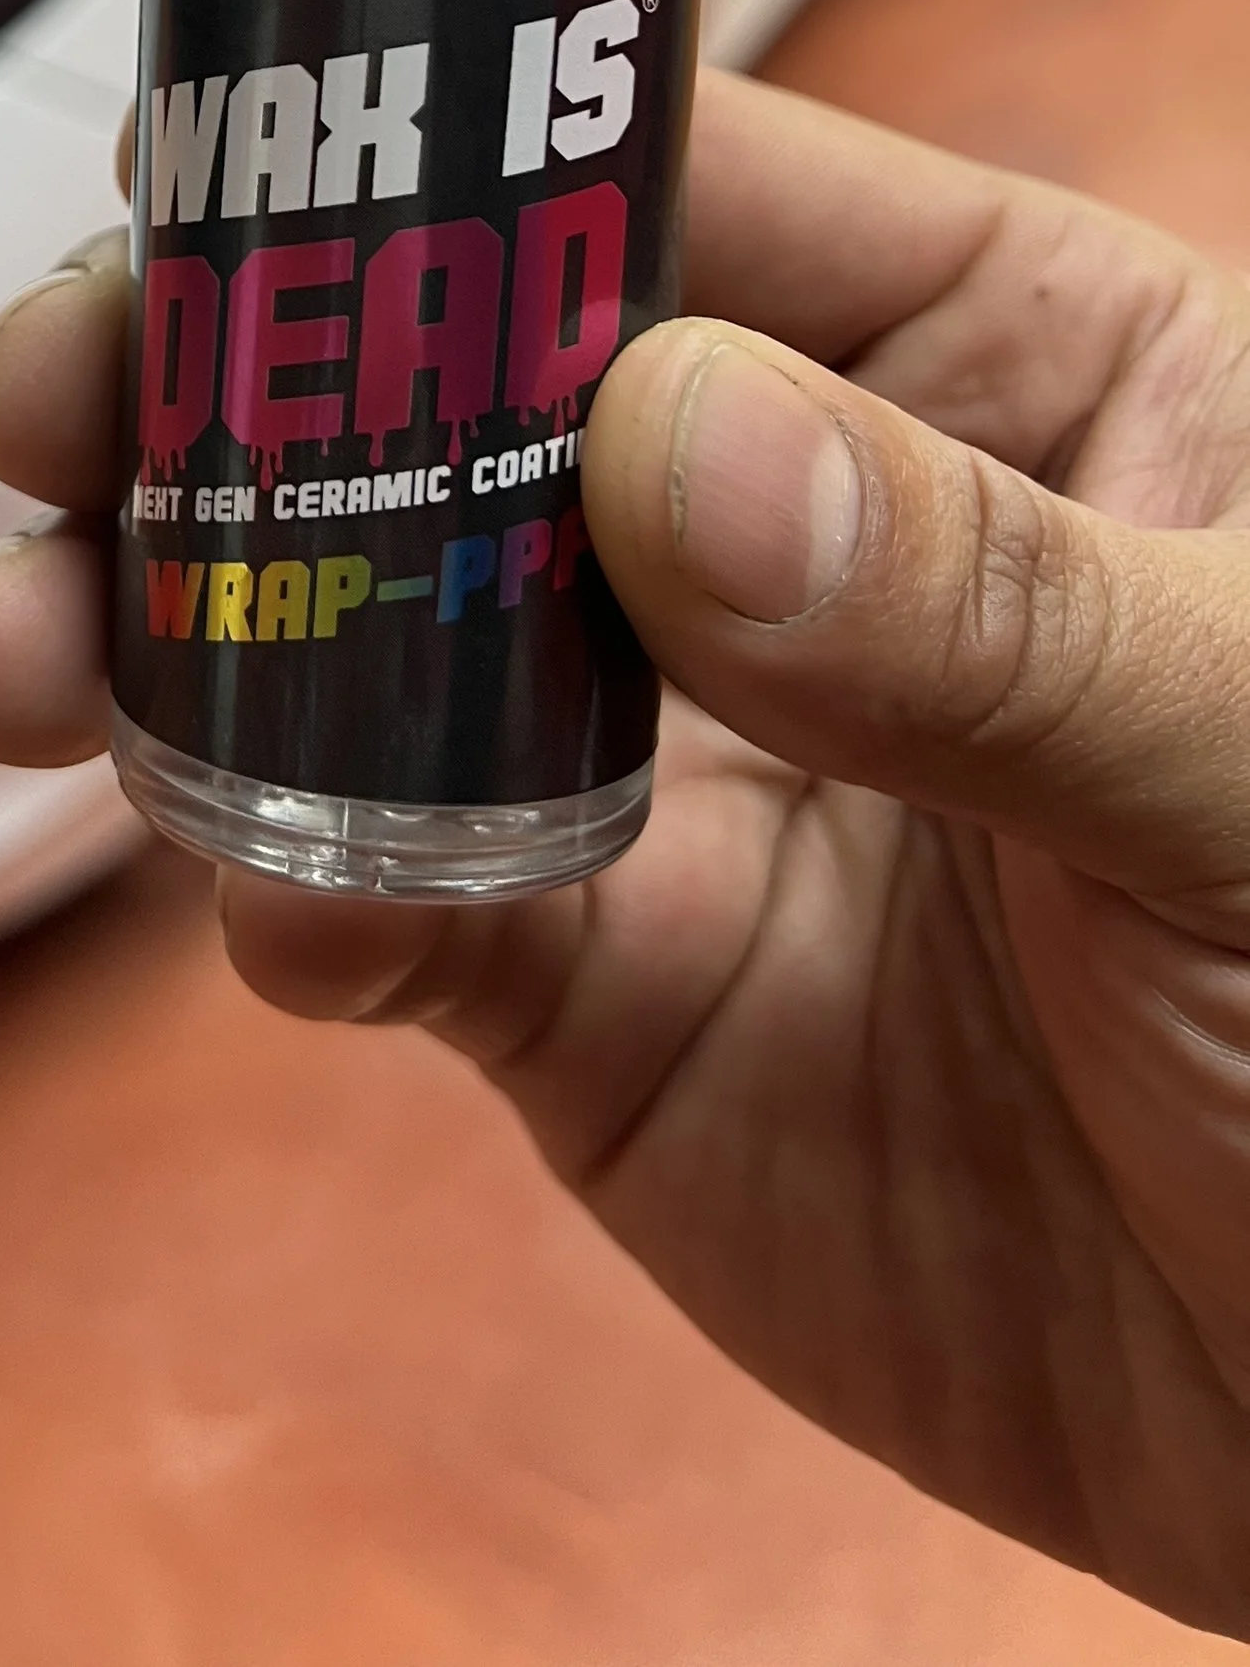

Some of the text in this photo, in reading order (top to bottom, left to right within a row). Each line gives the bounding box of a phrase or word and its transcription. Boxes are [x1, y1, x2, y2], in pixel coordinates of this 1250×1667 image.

[151, 42, 430, 226] WAX
[138, 180, 628, 484] DEAD
[133, 484, 183, 521] NEXT
[195, 486, 257, 522] GEN
[273, 465, 452, 520] CERAMIC
